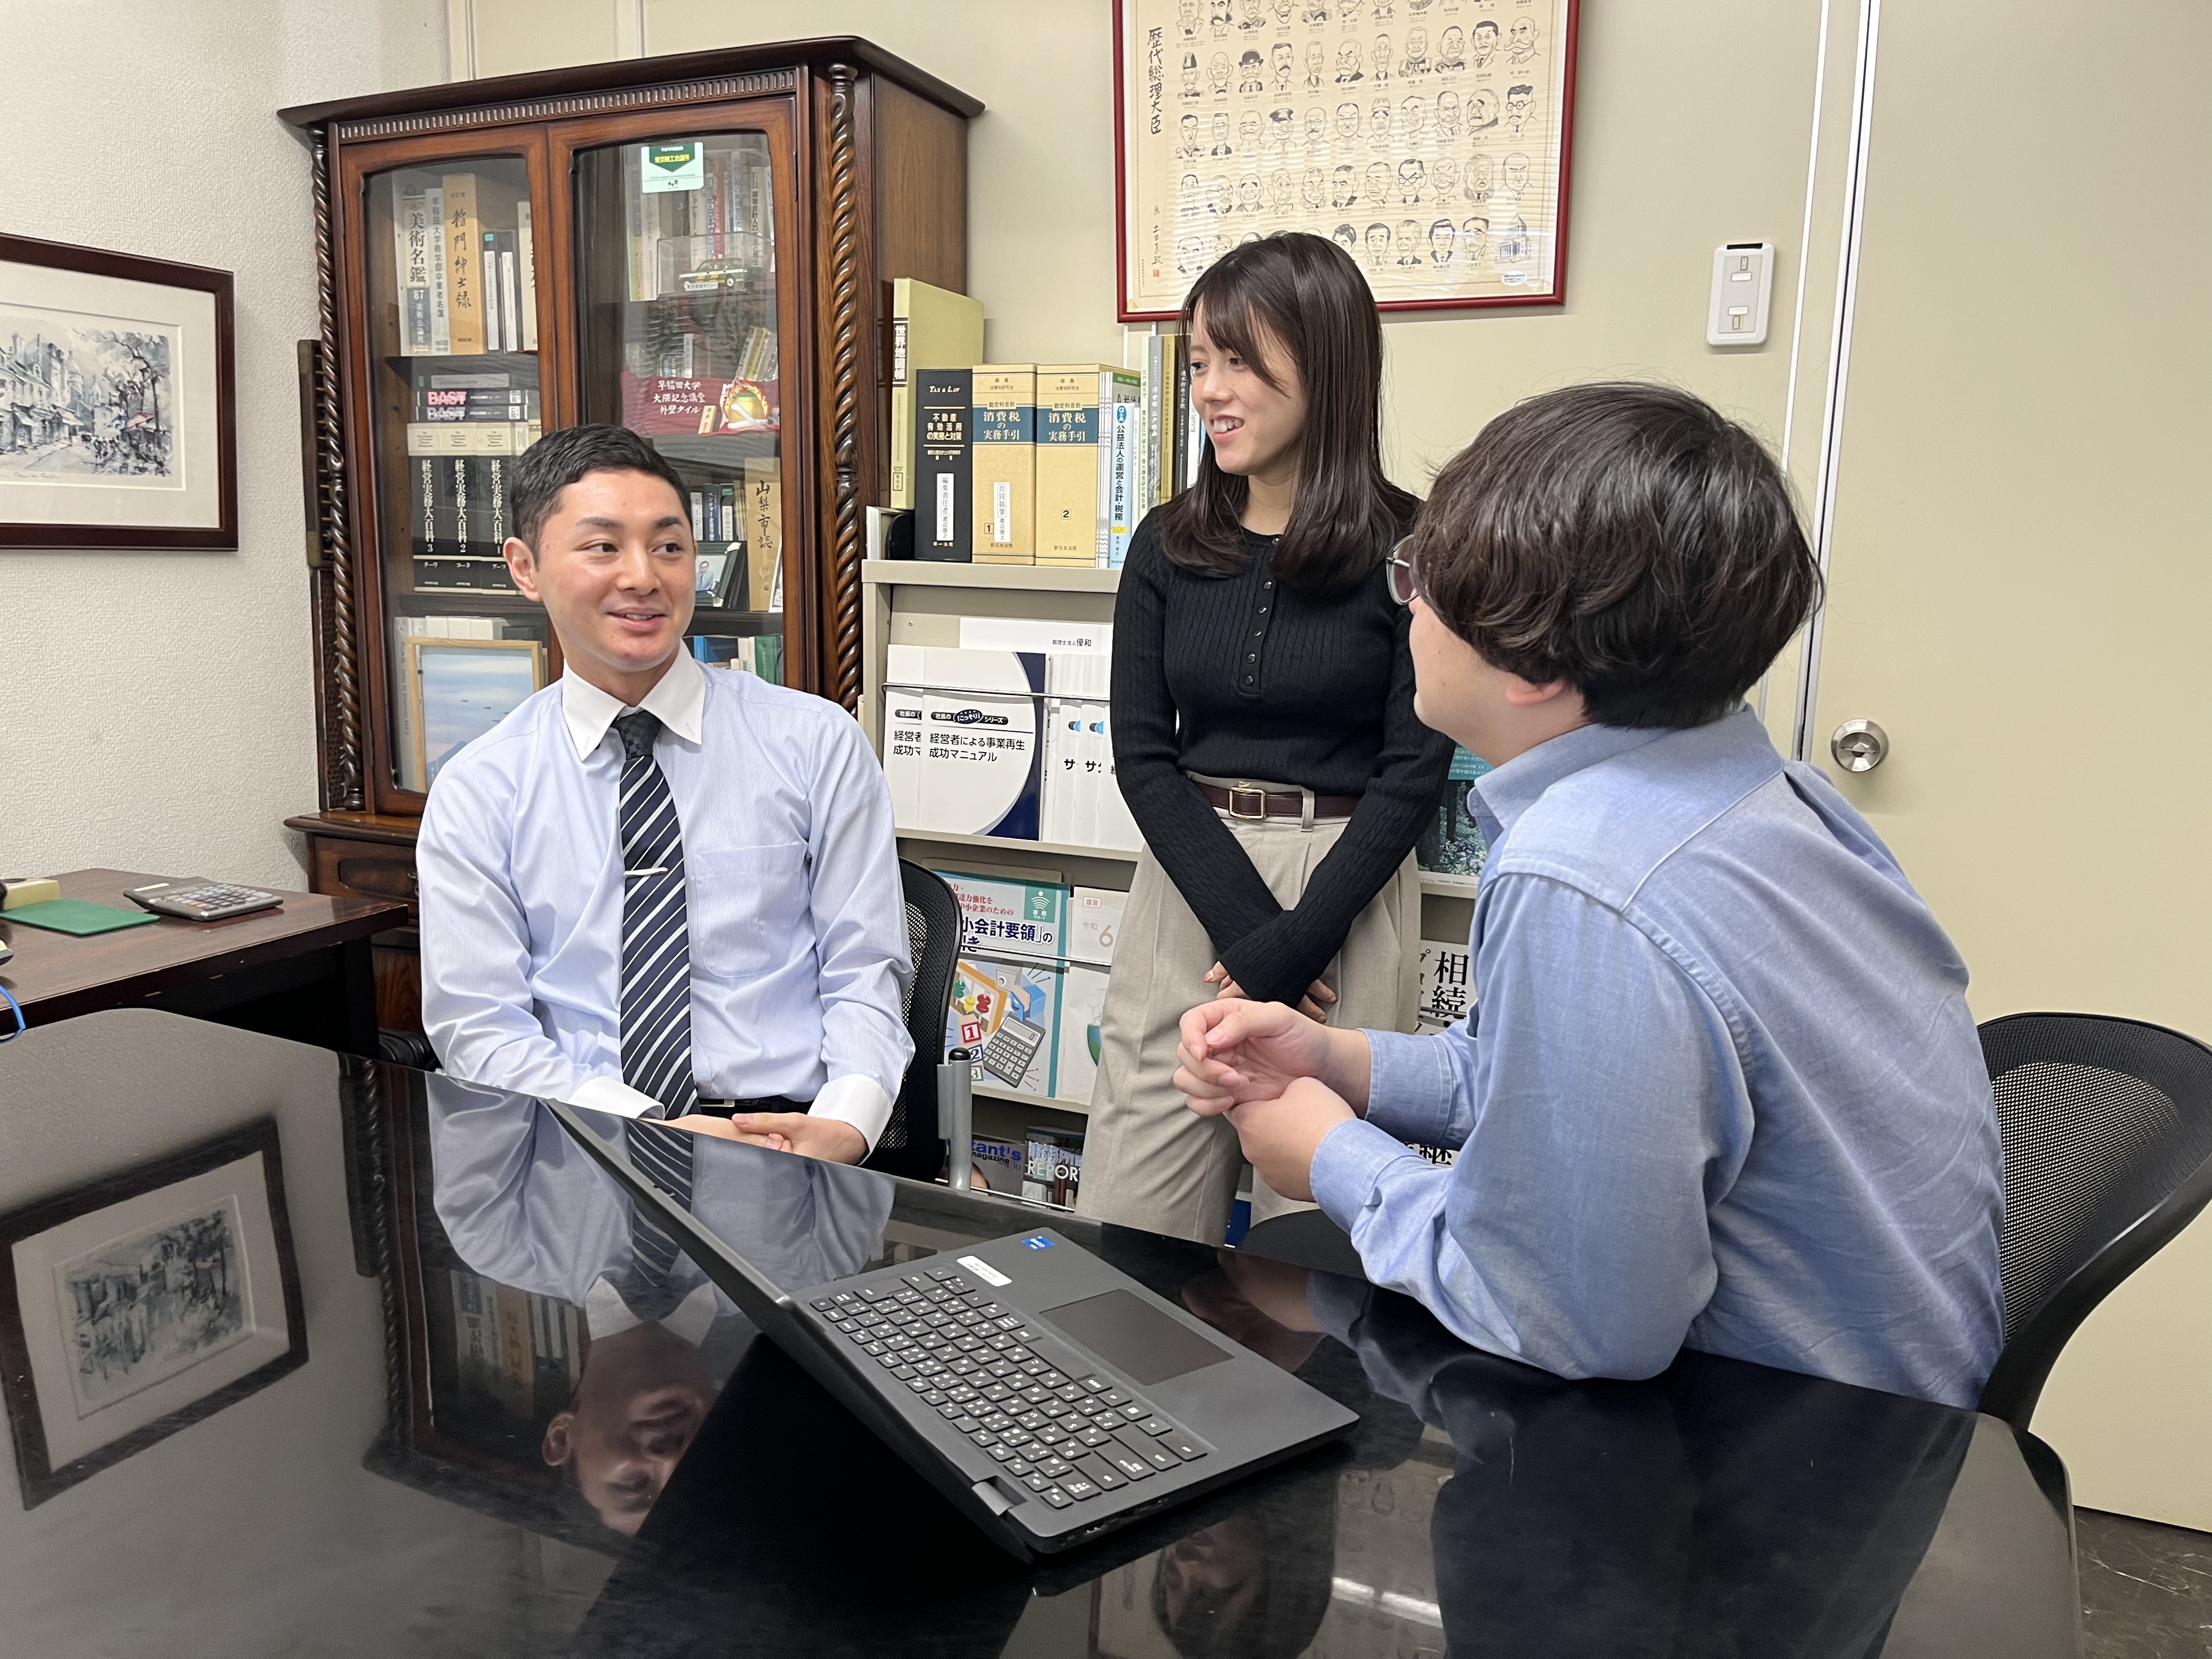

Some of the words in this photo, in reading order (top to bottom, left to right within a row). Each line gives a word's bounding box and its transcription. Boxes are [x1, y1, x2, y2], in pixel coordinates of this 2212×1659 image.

[1147, 26, 1164, 135] 歴代総理大臣
[409, 212, 426, 283] 美術名鑑
[413, 290, 424, 300] 87
[658, 380, 701, 391] 早稲田大学
[428, 391, 466, 405] BAST
[660, 405, 700, 415] 外壁タイル
[933, 413, 957, 422] 不動産
[983, 411, 1020, 422] 消費税
[1048, 412, 1086, 424] 消費税
[927, 422, 962, 431] 有効活用
[927, 432, 962, 441] の実務と対策
[983, 430, 1019, 440] 実務手引
[1048, 431, 1086, 442] 実務手引
[1115, 425, 1125, 521] 公益法人の運営と会計・税務
[756, 479, 773, 549] 山梨市誌
[1063, 510, 1070, 518] 2
[986, 524, 991, 533] 1
[427, 544, 433, 552] 3
[497, 546, 500, 554] 1
[1052, 638, 1092, 647] 税理士法人優和
[929, 732, 1025, 751] 経営者による事業再生
[929, 747, 997, 762] 成功マニュアル
[1082, 921, 1097, 930] 令和
[1099, 924, 1114, 947] 6
[966, 1026, 975, 1039] 1
[970, 1048, 980, 1060] 2
[1028, 1160, 1081, 1182] REPOR
